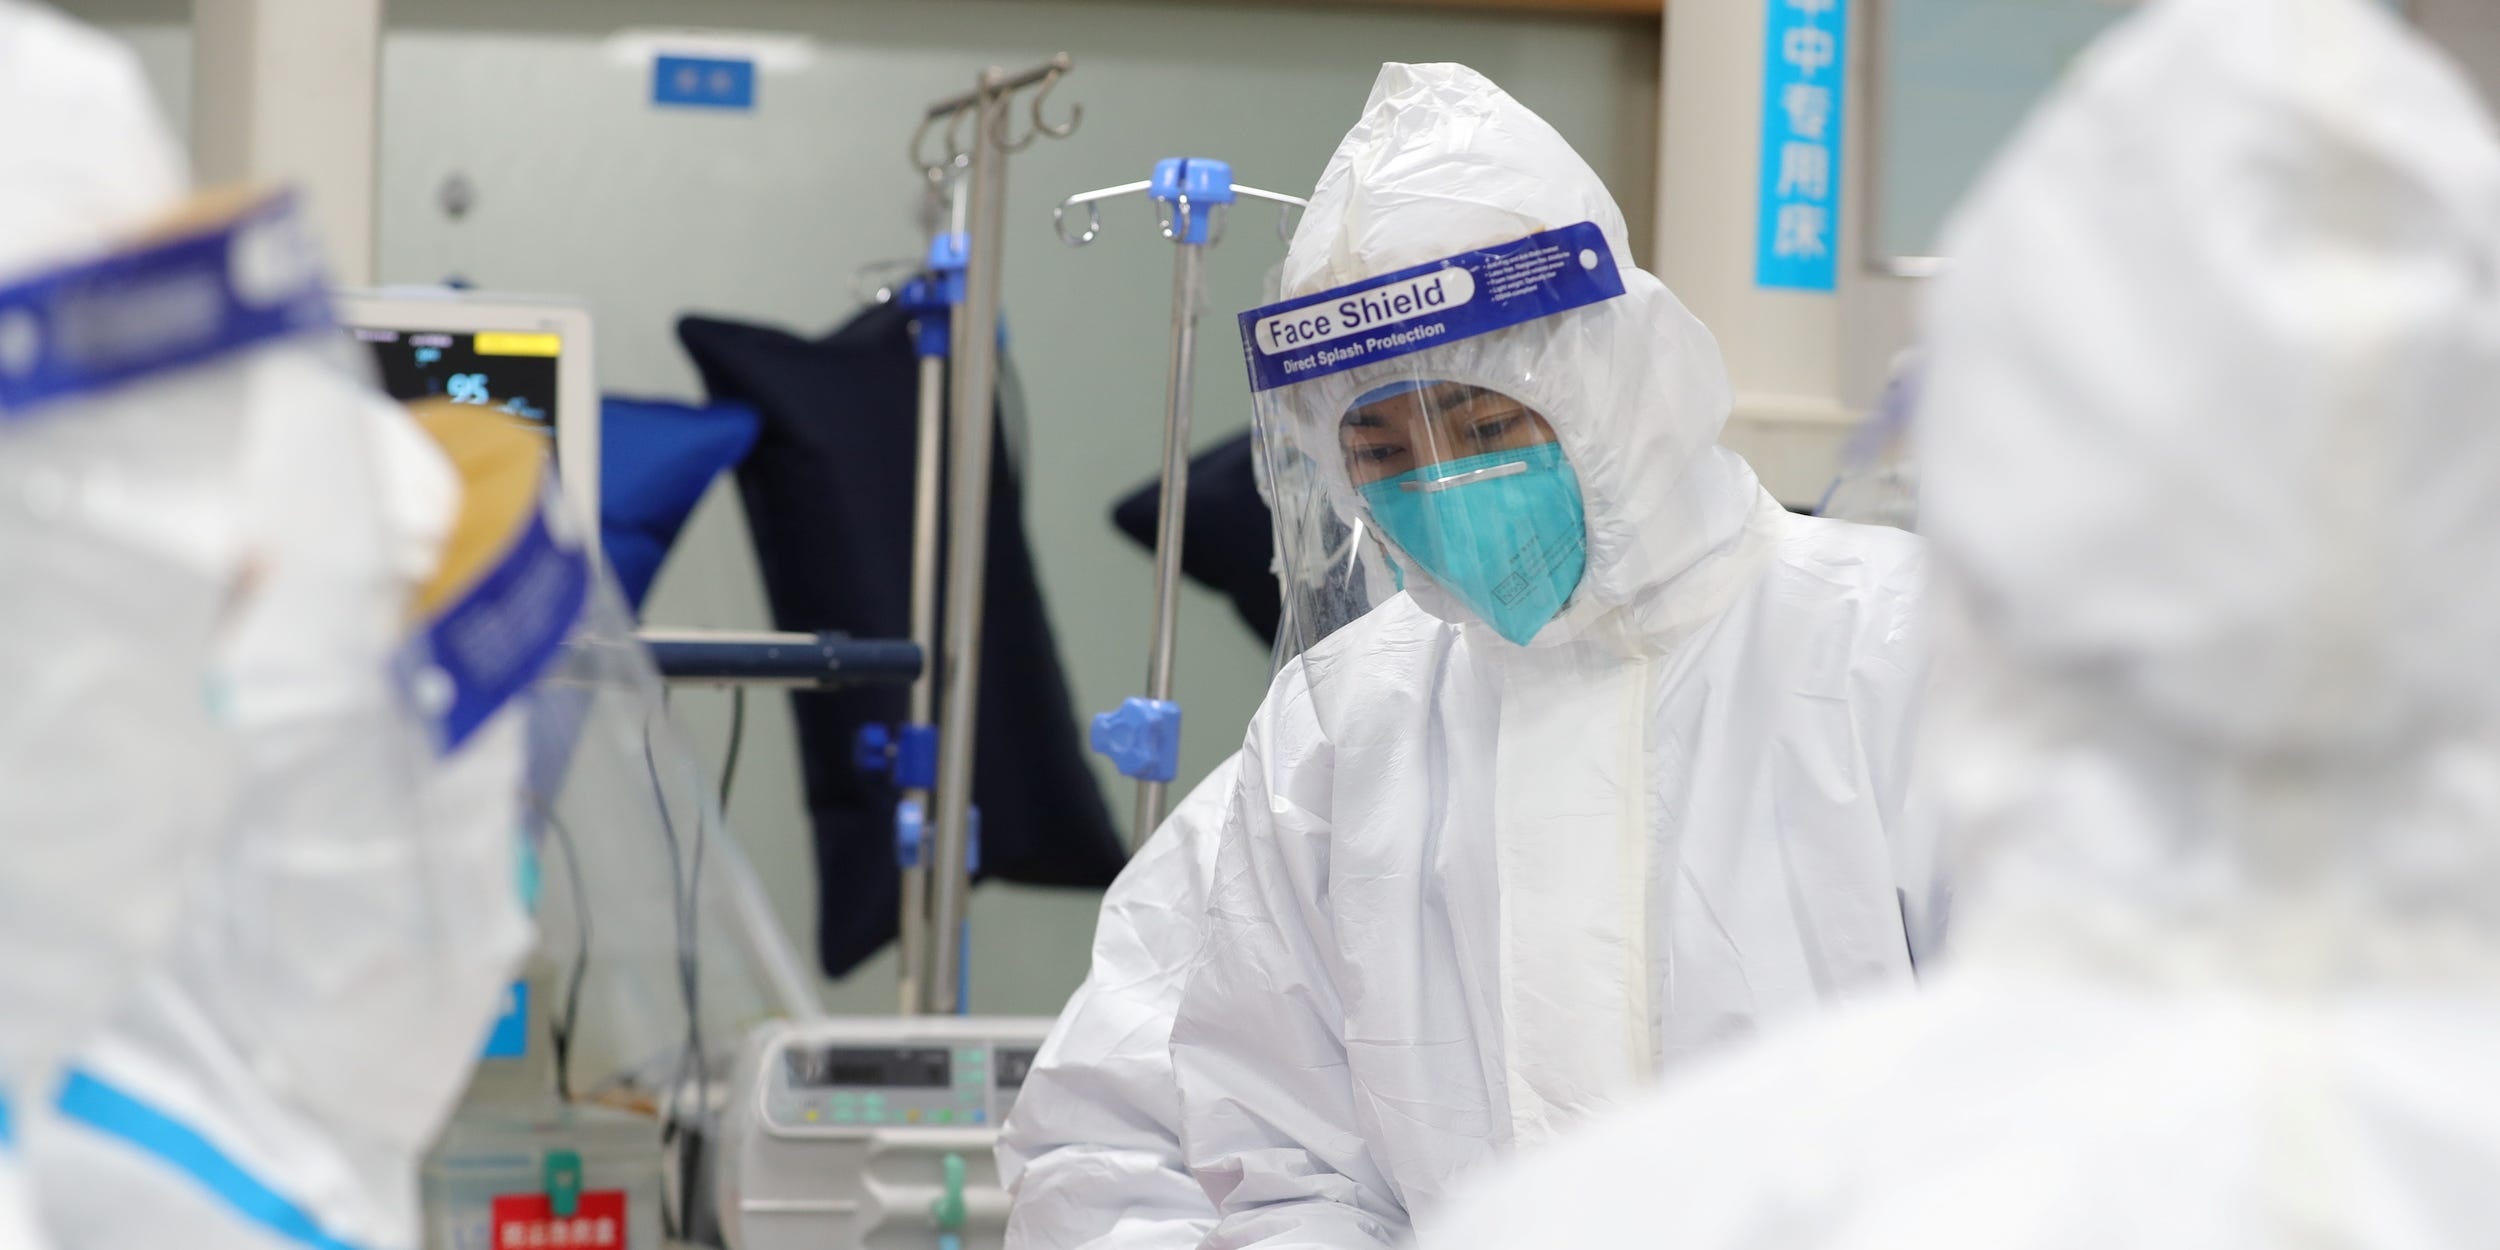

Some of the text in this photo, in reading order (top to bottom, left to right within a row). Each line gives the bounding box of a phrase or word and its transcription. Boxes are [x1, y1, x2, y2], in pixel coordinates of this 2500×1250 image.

[1270, 278, 1445, 348] Face Shield
[1283, 322, 1445, 374] Direct Splash Protection
